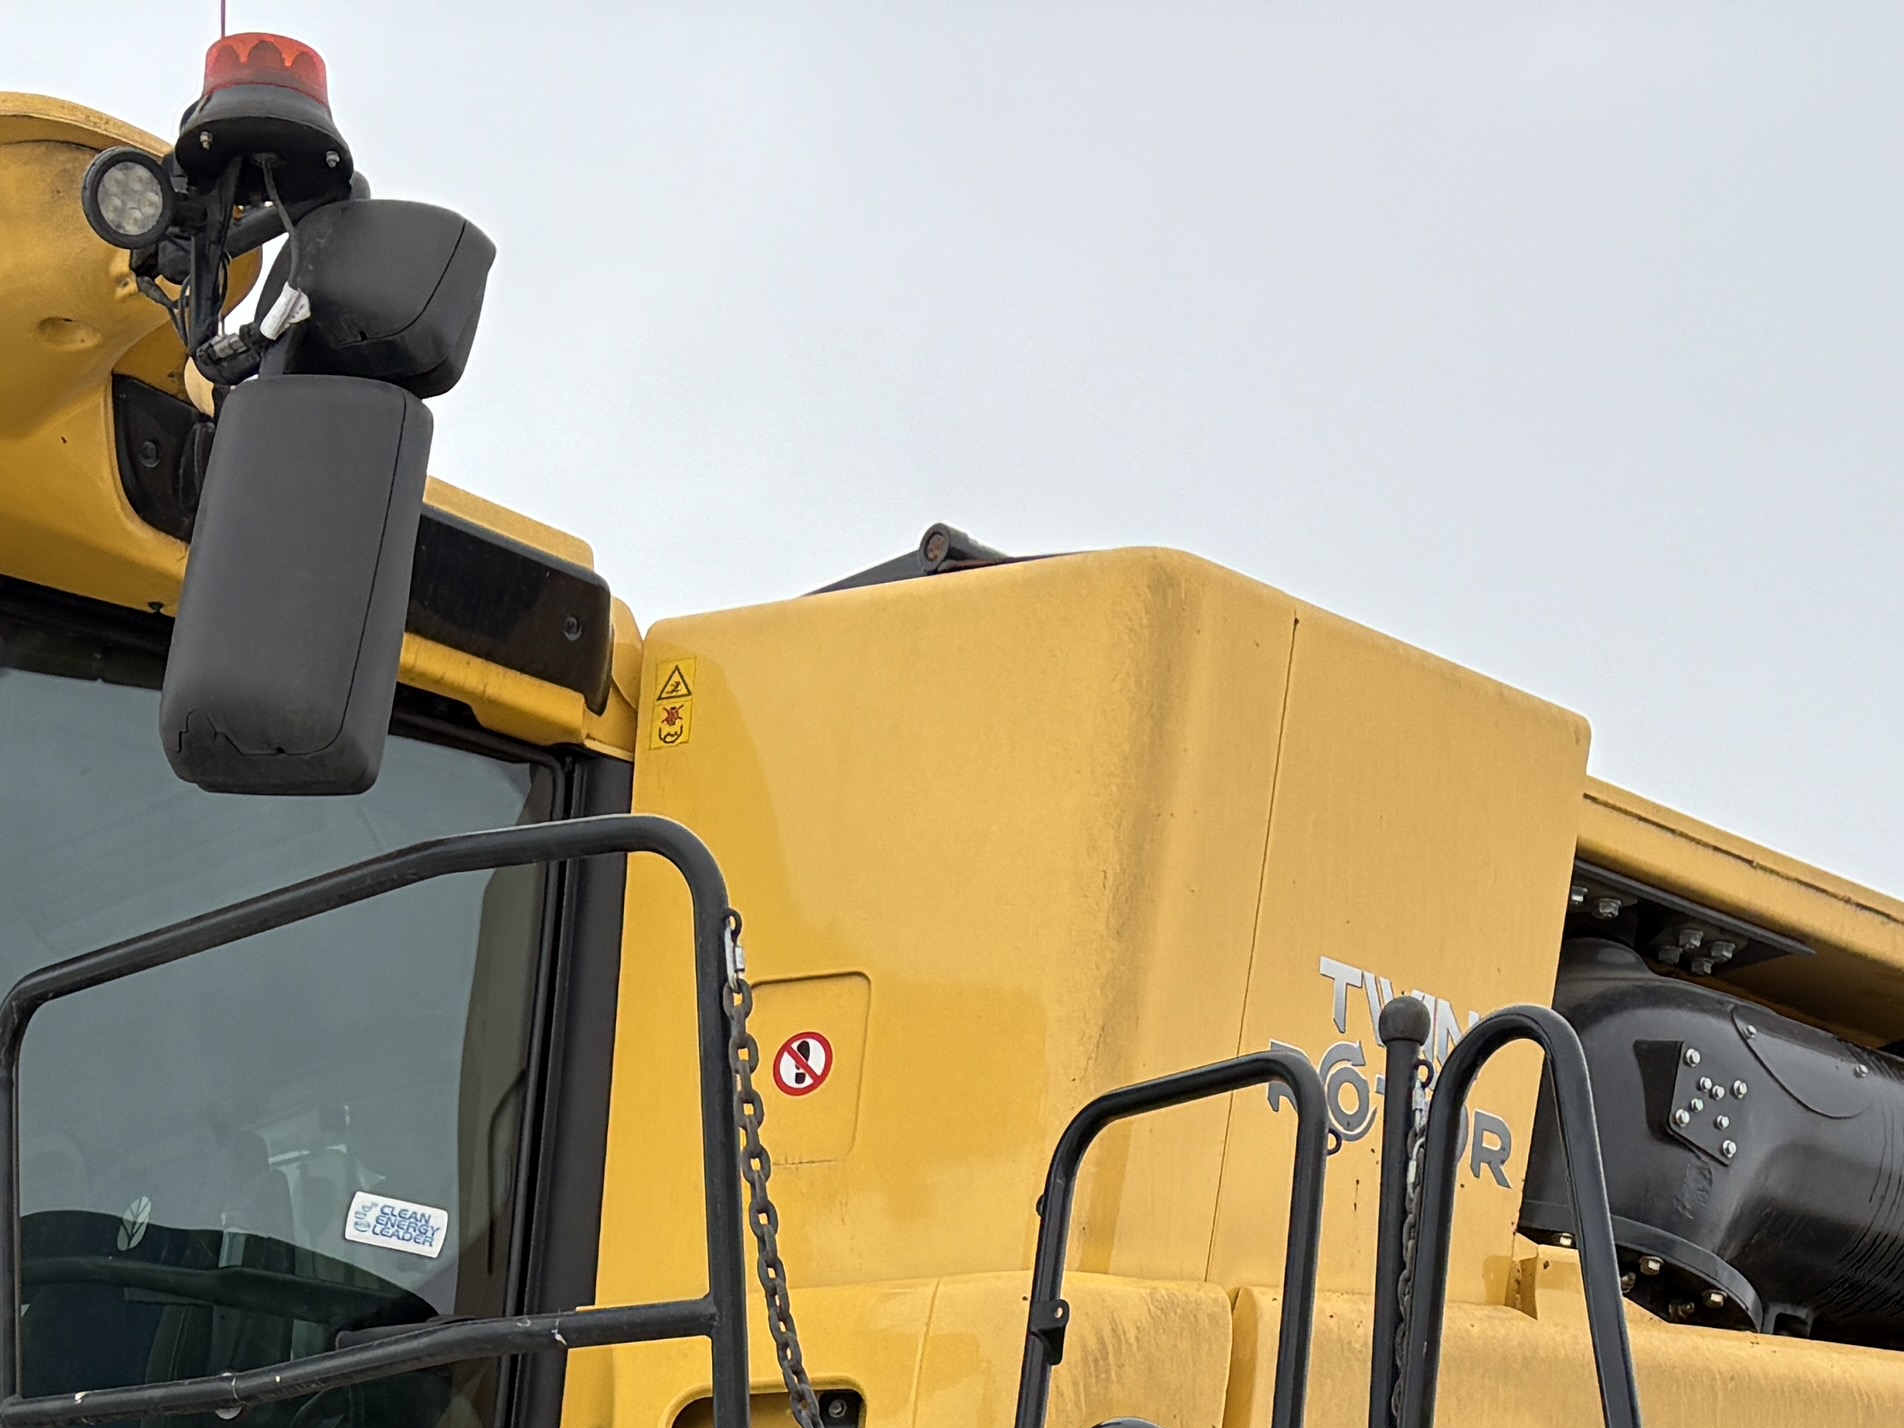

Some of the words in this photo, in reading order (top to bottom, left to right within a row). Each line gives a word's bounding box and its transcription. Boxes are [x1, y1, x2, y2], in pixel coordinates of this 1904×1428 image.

[375, 1214, 441, 1237] ENERGY
[380, 1204, 432, 1224] CLEAN
[371, 1224, 435, 1248] LEADER
